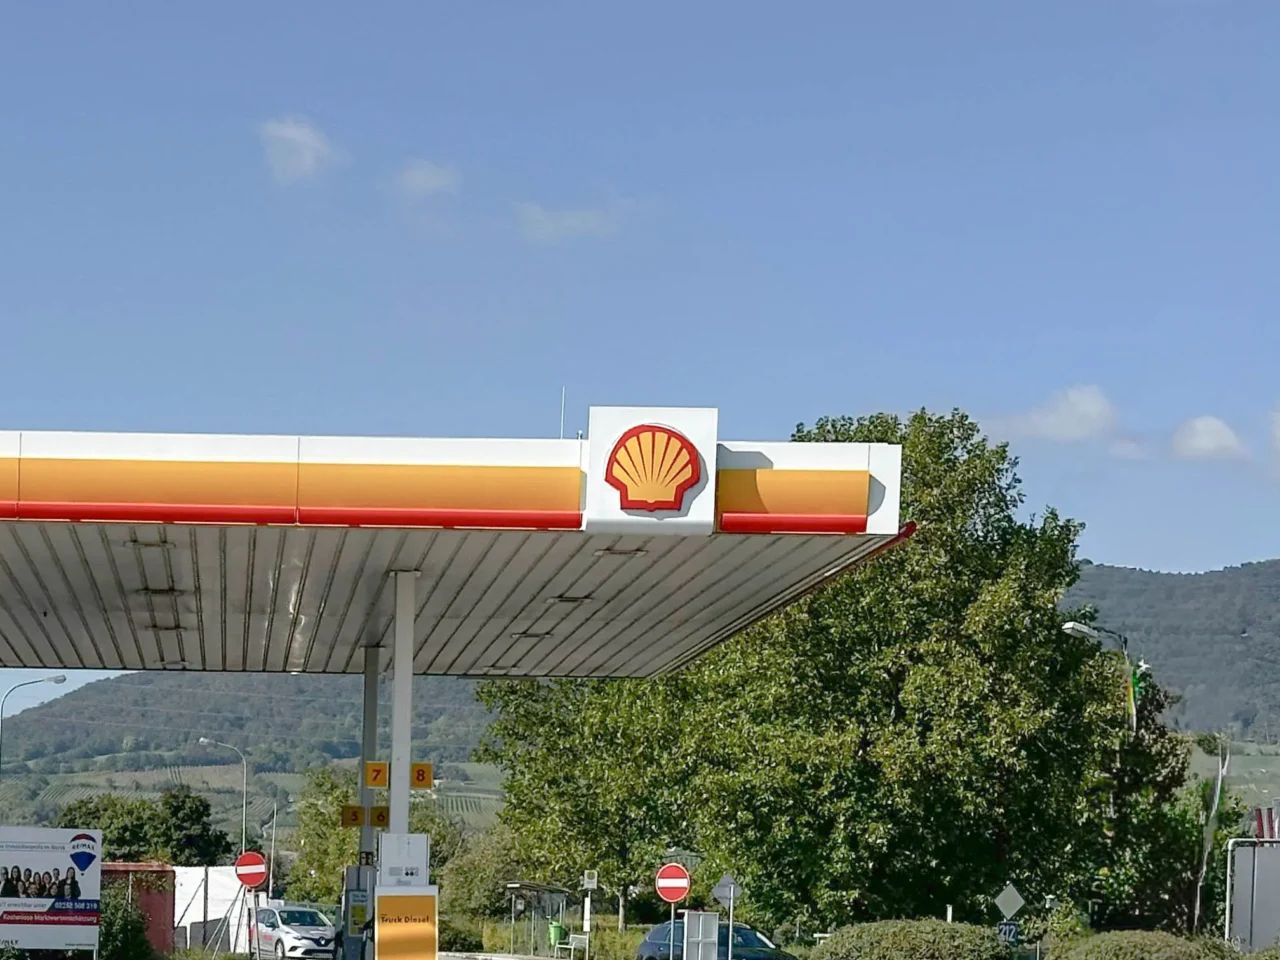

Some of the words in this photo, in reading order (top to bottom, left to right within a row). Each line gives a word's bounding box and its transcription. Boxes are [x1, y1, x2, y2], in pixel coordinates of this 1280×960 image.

[372, 769, 381, 782] 7
[415, 769, 426, 782] 8
[351, 811, 358, 821] 5
[377, 811, 385, 822] 6
[72, 843, 95, 851] RE/MAX
[404, 915, 429, 923] Diesel
[1000, 925, 1015, 941] 212
